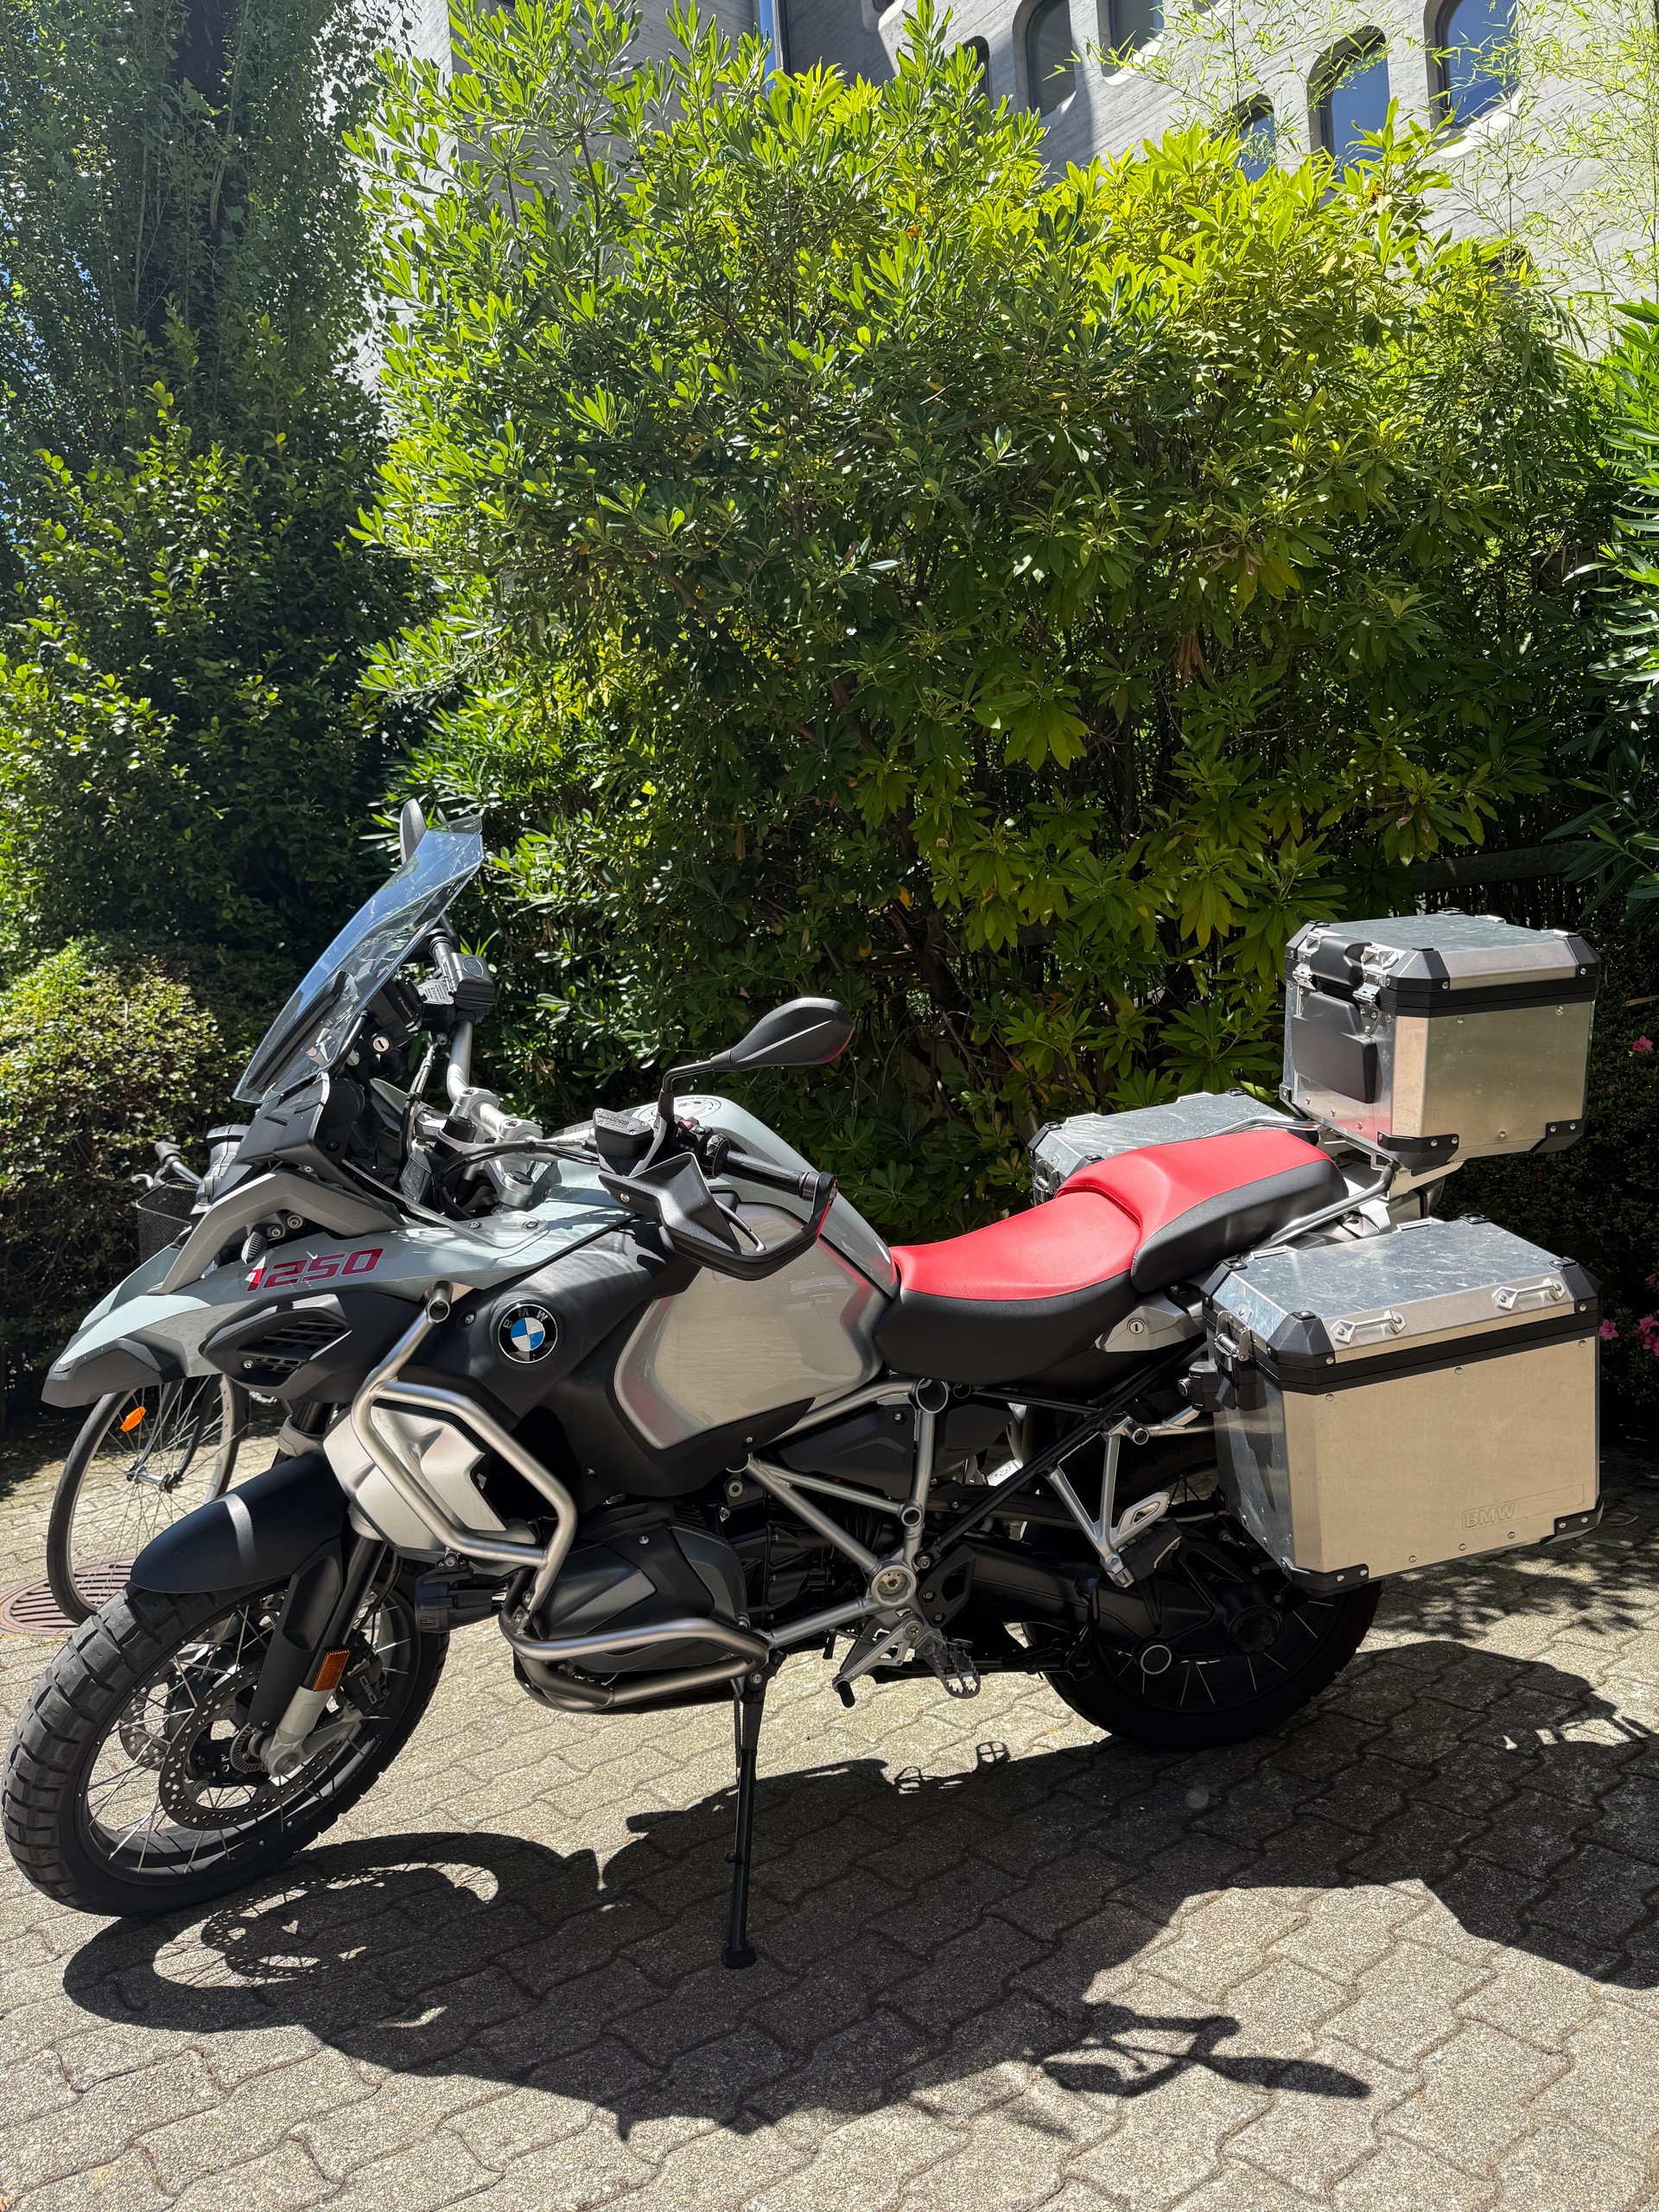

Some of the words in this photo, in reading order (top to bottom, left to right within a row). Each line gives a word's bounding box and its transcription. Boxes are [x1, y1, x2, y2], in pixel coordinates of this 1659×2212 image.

[245, 1248, 385, 1293] 1250
[503, 1307, 549, 1330] BMW
[1465, 1503, 1516, 1529] BMW
